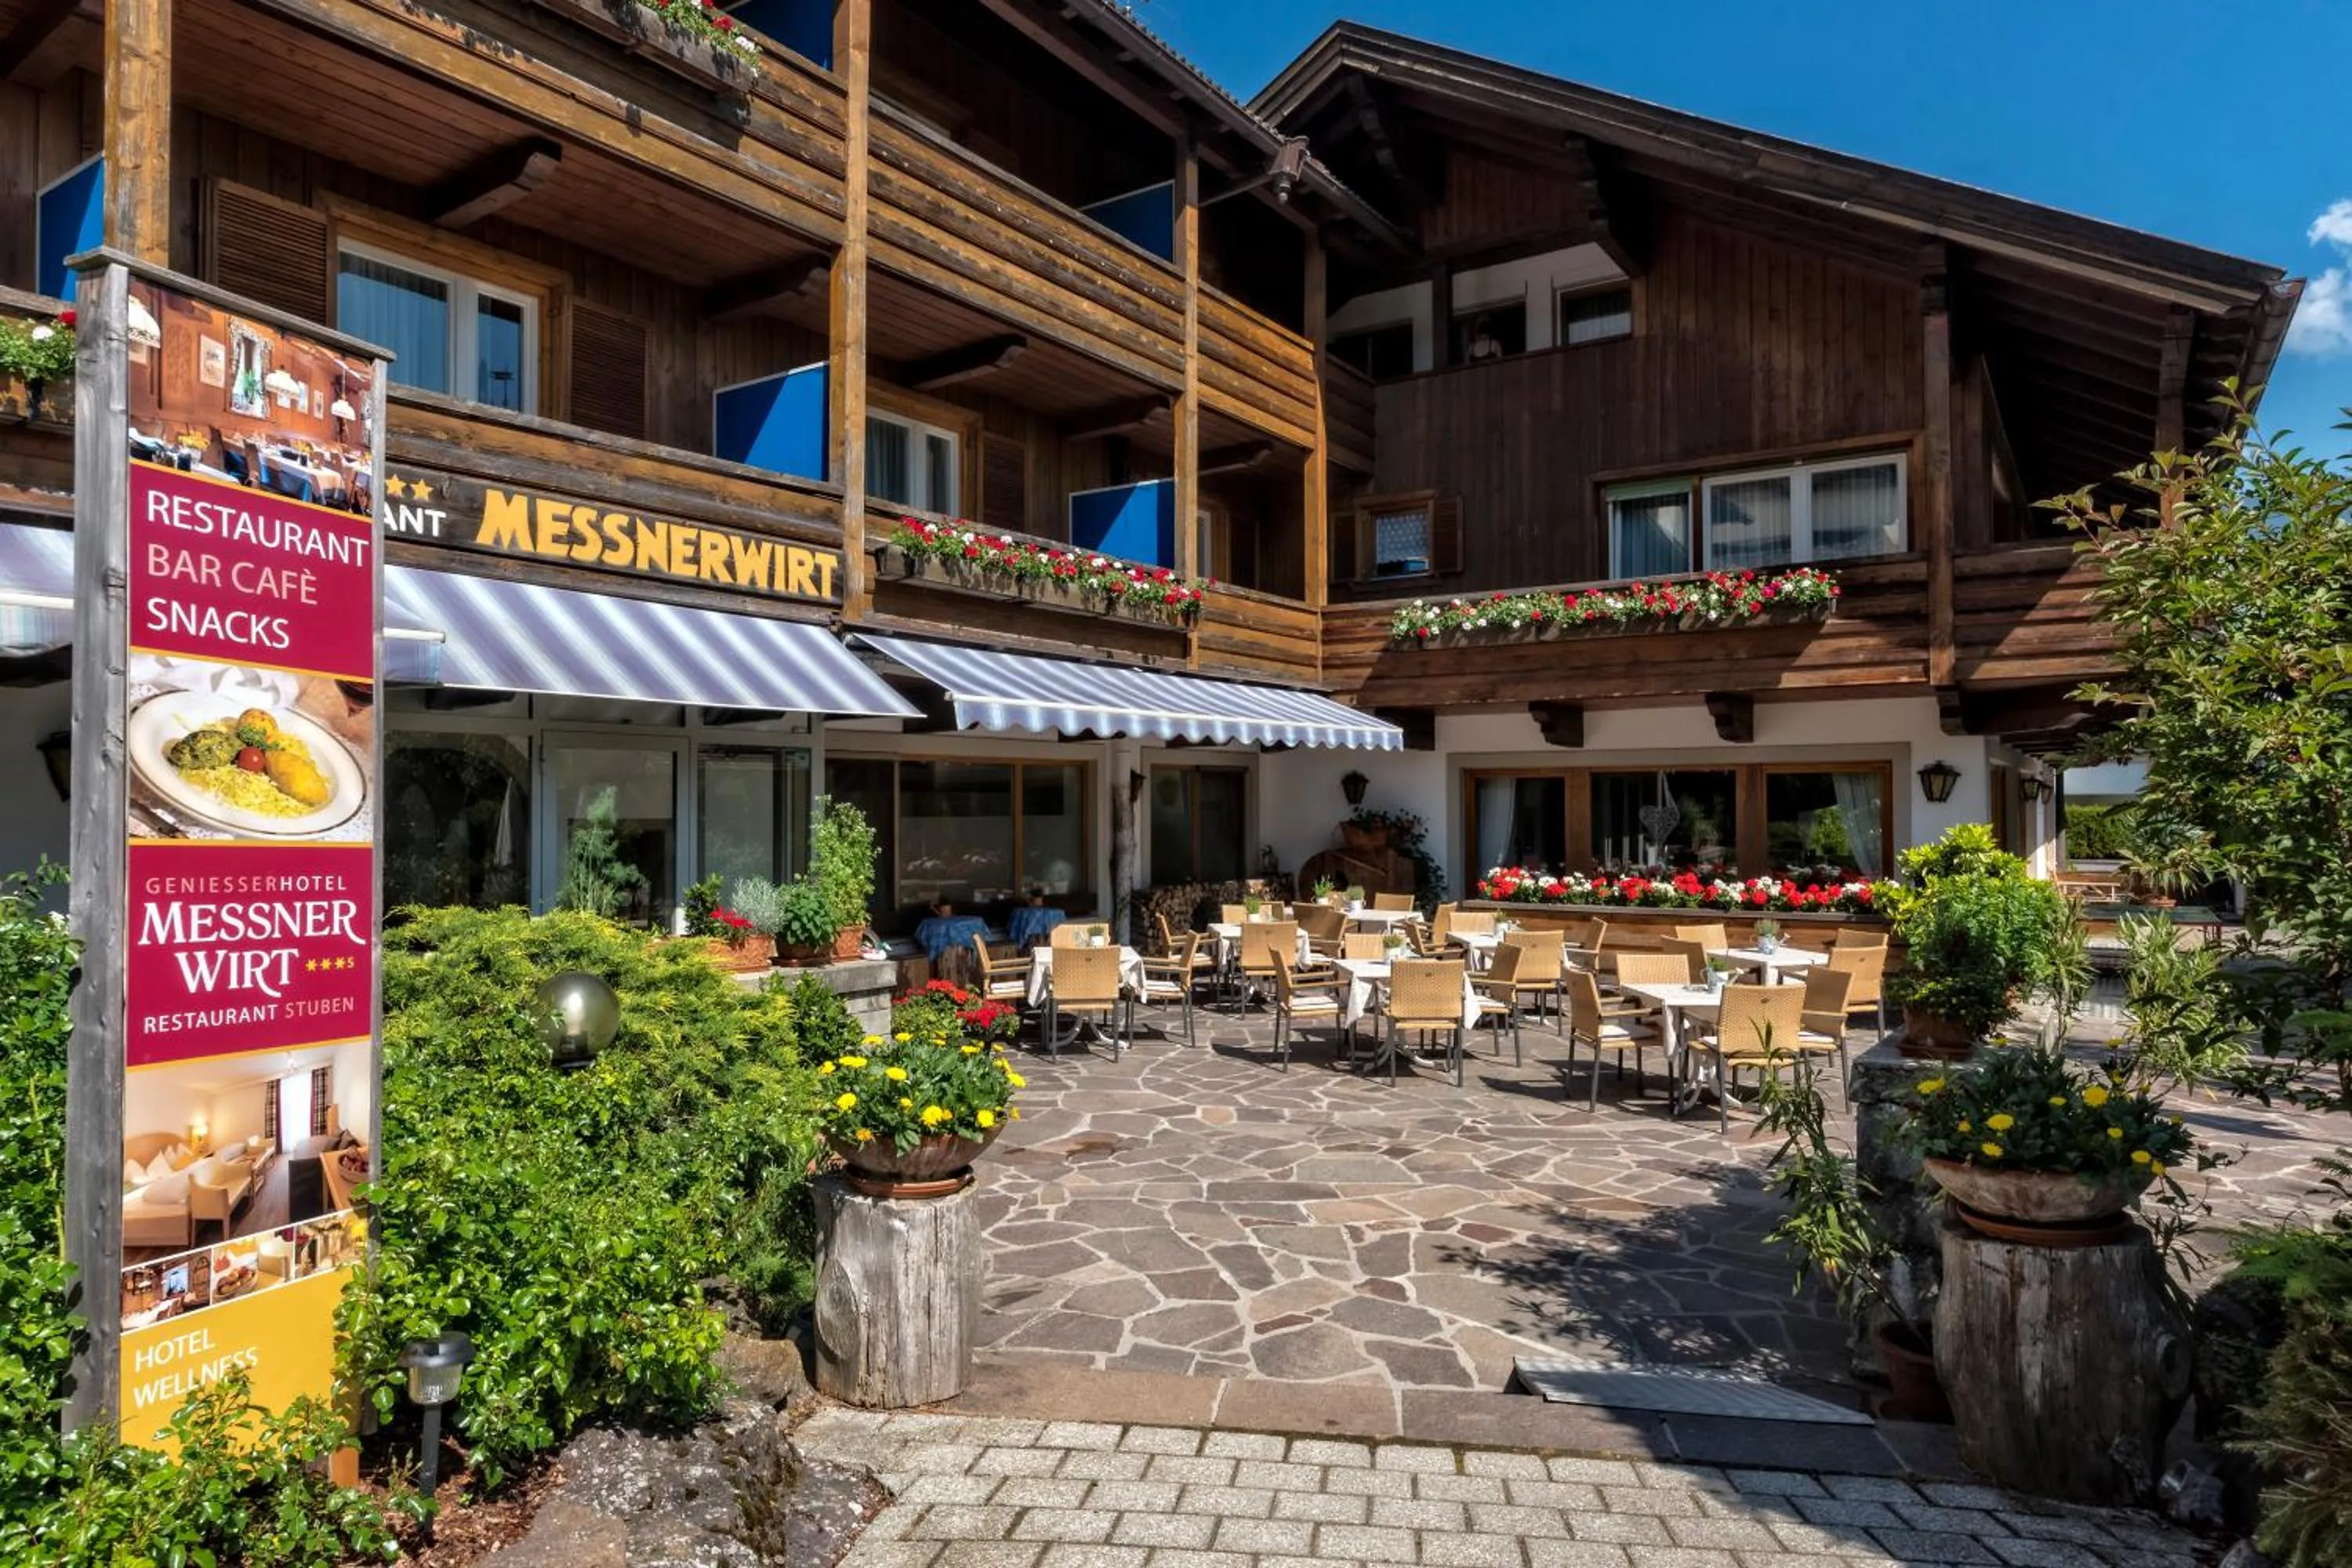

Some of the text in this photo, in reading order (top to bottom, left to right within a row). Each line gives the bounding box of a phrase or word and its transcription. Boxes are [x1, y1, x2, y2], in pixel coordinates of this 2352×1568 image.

[147, 489, 369, 568] RESTAURANT
[475, 489, 838, 599] MESSNERWIRT
[147, 543, 318, 604] BAR CAFÈ
[147, 597, 290, 649] SNACKS
[145, 876, 347, 895] GENIESSERHOTEL
[137, 900, 366, 946] MESSNER
[174, 948, 299, 998] WIRT
[143, 997, 354, 1034] RESTAURANT STUBEN
[135, 1327, 216, 1373] HOTEL
[132, 1346, 259, 1409] WELLNESS
